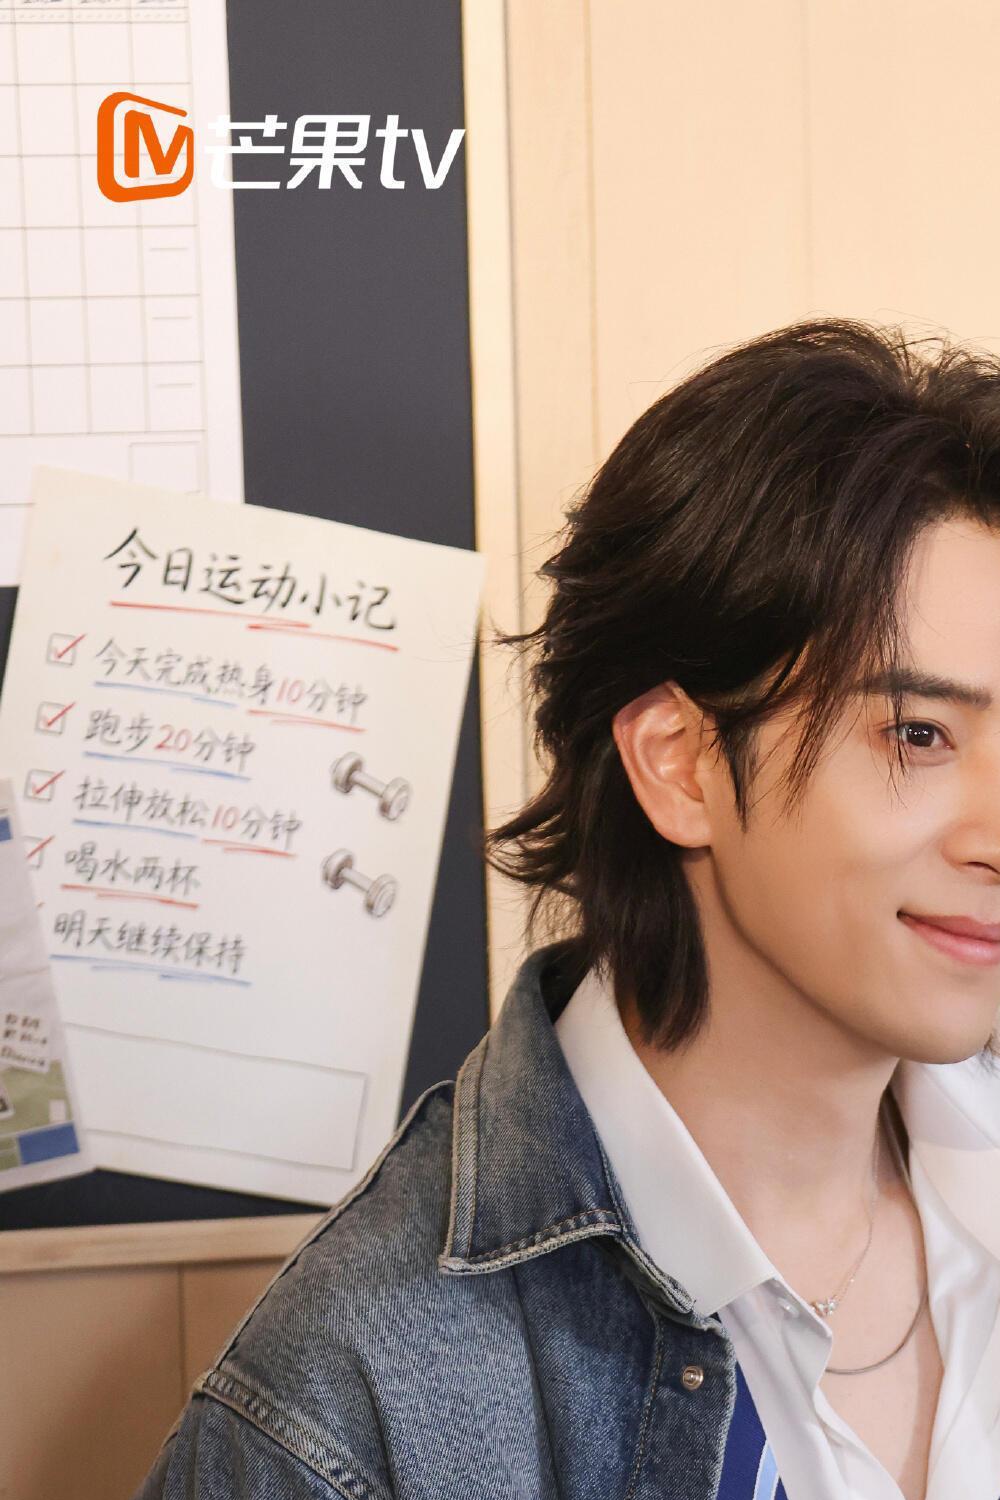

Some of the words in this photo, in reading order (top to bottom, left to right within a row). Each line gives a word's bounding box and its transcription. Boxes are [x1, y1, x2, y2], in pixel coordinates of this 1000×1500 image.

[104, 528, 396, 631] 今日运动小记
[95, 638, 368, 722] 今天完成热身10分钟
[83, 709, 255, 772] 跑步20分钟
[73, 775, 301, 849] 拉伸放松10分钟
[64, 841, 200, 897] 喝水两杯
[53, 909, 247, 975] 明天继续保持
